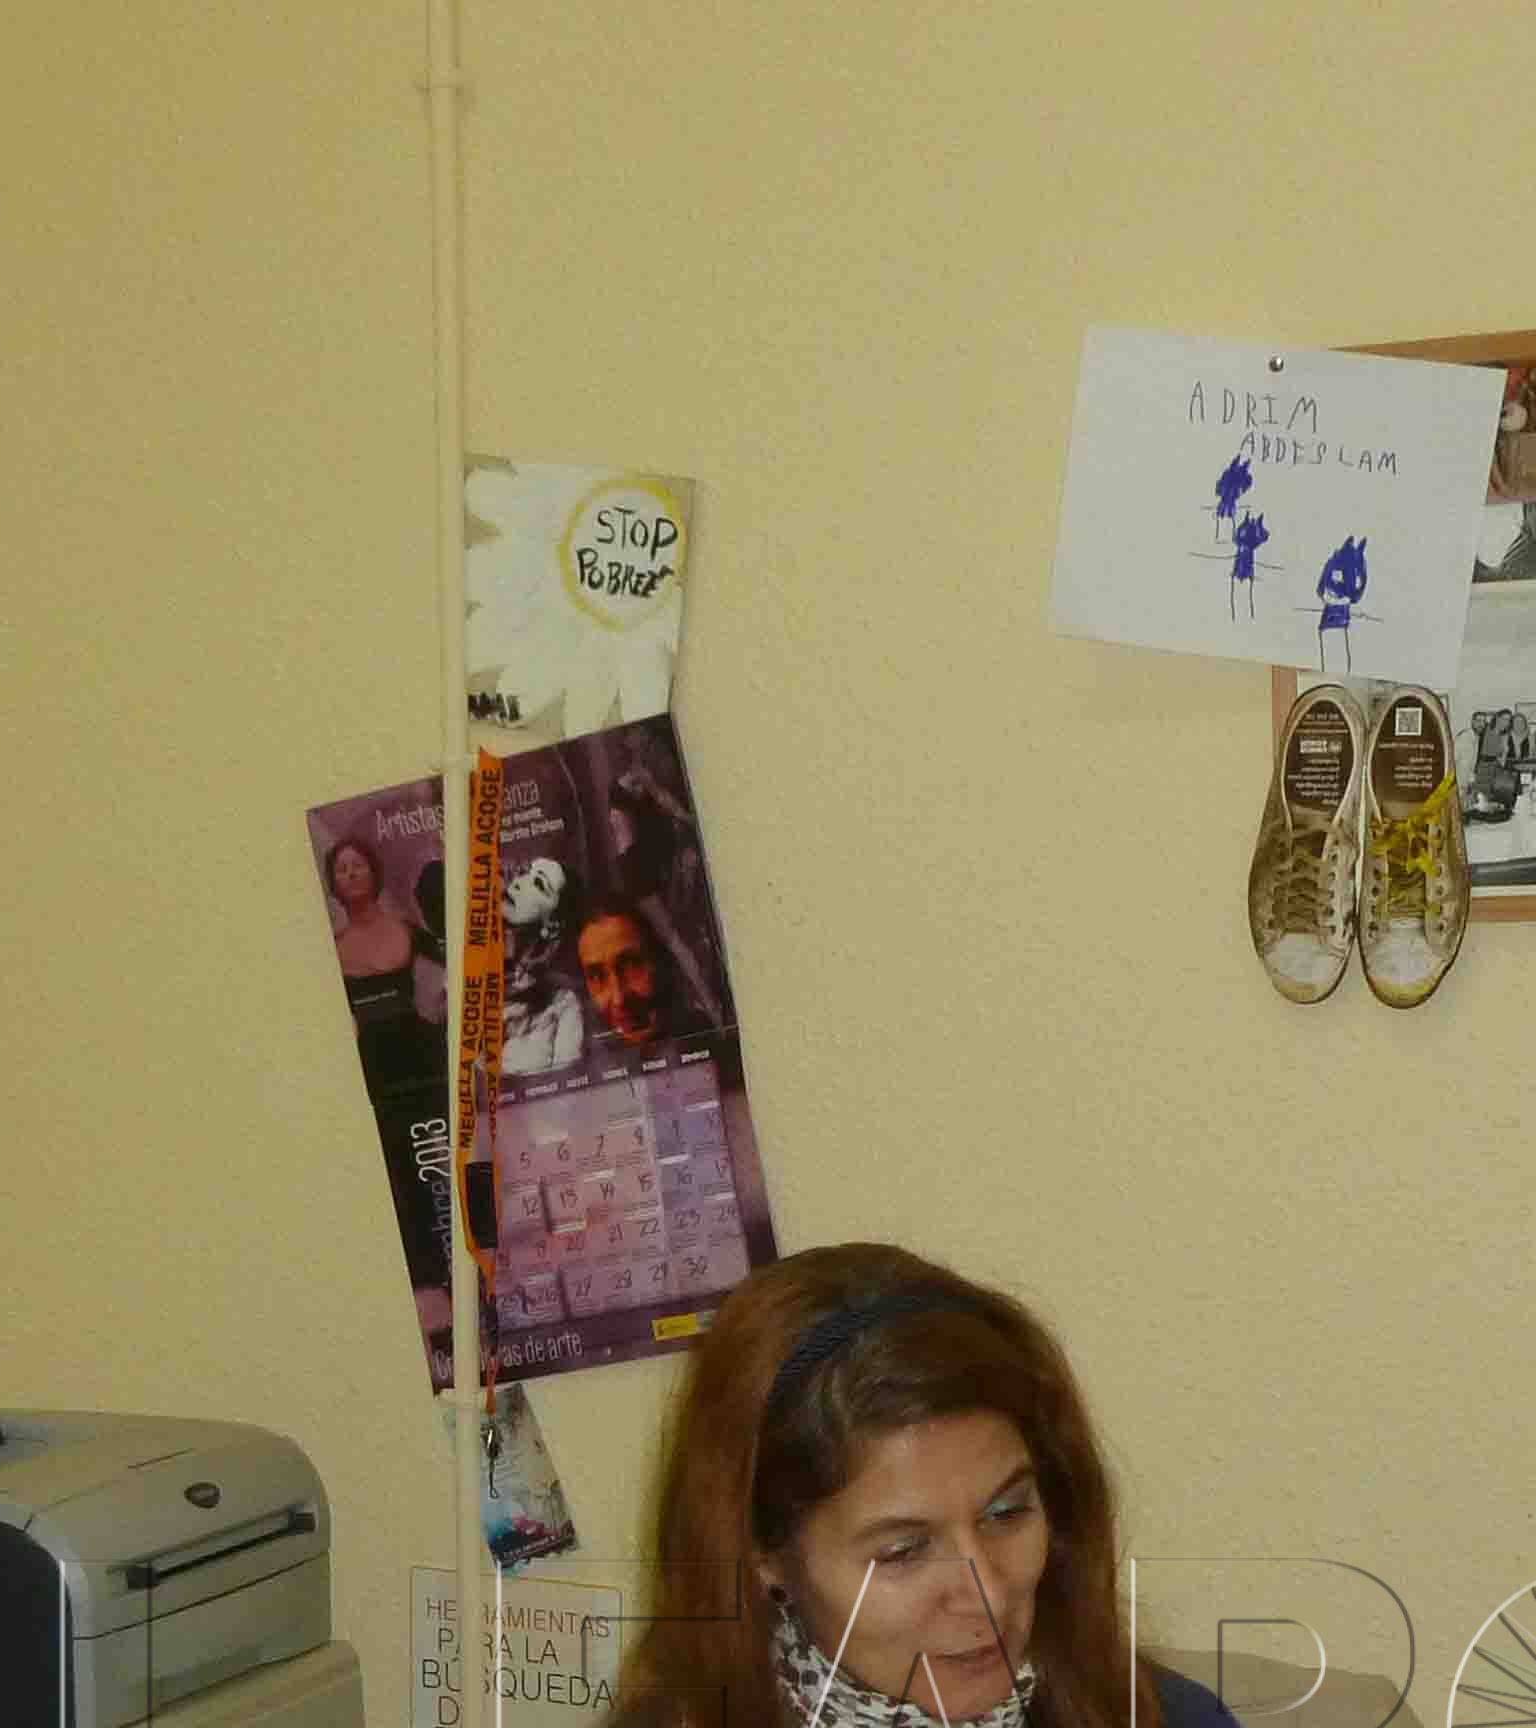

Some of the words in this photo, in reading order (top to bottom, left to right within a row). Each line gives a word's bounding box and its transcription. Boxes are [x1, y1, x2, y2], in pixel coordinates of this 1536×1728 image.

[595, 506, 678, 562] STOP
[476, 767, 501, 846] ACOGE
[467, 853, 491, 946] MELILLA
[462, 975, 483, 1049] ACOGE
[409, 1117, 452, 1183] 2013
[525, 1637, 560, 1666] LA
[437, 1695, 462, 1727] D
